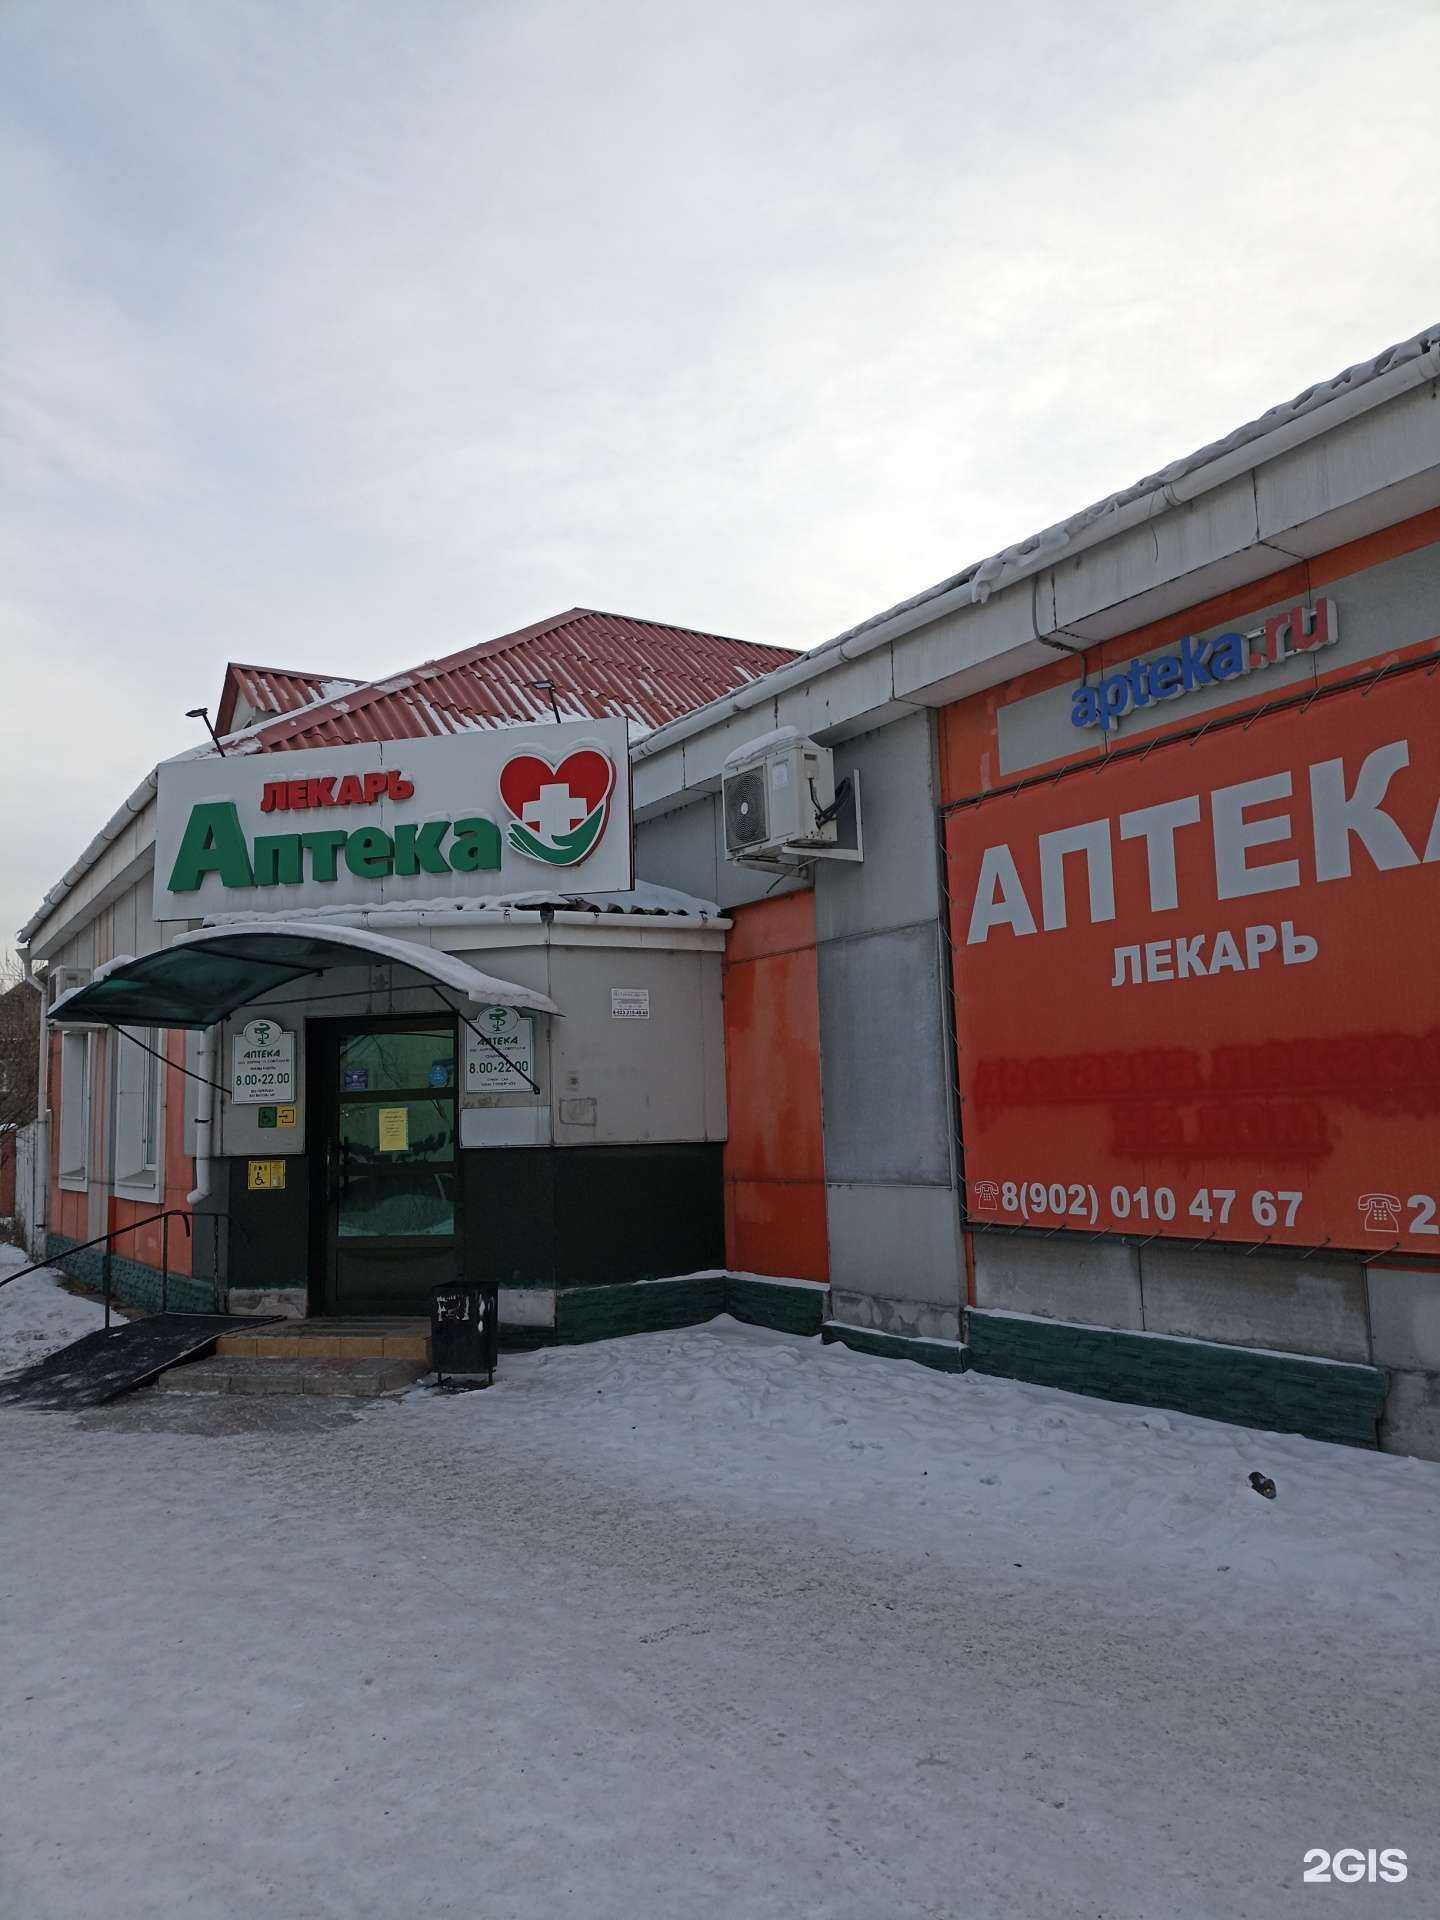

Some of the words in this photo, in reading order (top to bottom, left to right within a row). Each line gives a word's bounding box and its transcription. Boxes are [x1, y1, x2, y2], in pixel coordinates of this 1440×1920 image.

[1071, 597, 1340, 731] apteka.ru
[260, 770, 415, 812] ЛЕКАРЬ
[167, 801, 502, 893] Аптека
[966, 739, 1440, 945] АПТЕК
[1111, 920, 1319, 987] ЛЕКАРЬ
[244, 1049, 281, 1058] АПТЕКА
[1001, 1181, 1099, 1225] 8(902)
[1110, 1185, 1177, 1221] 010
[1188, 1188, 1237, 1224] 47
[1251, 1190, 1303, 1227] 67
